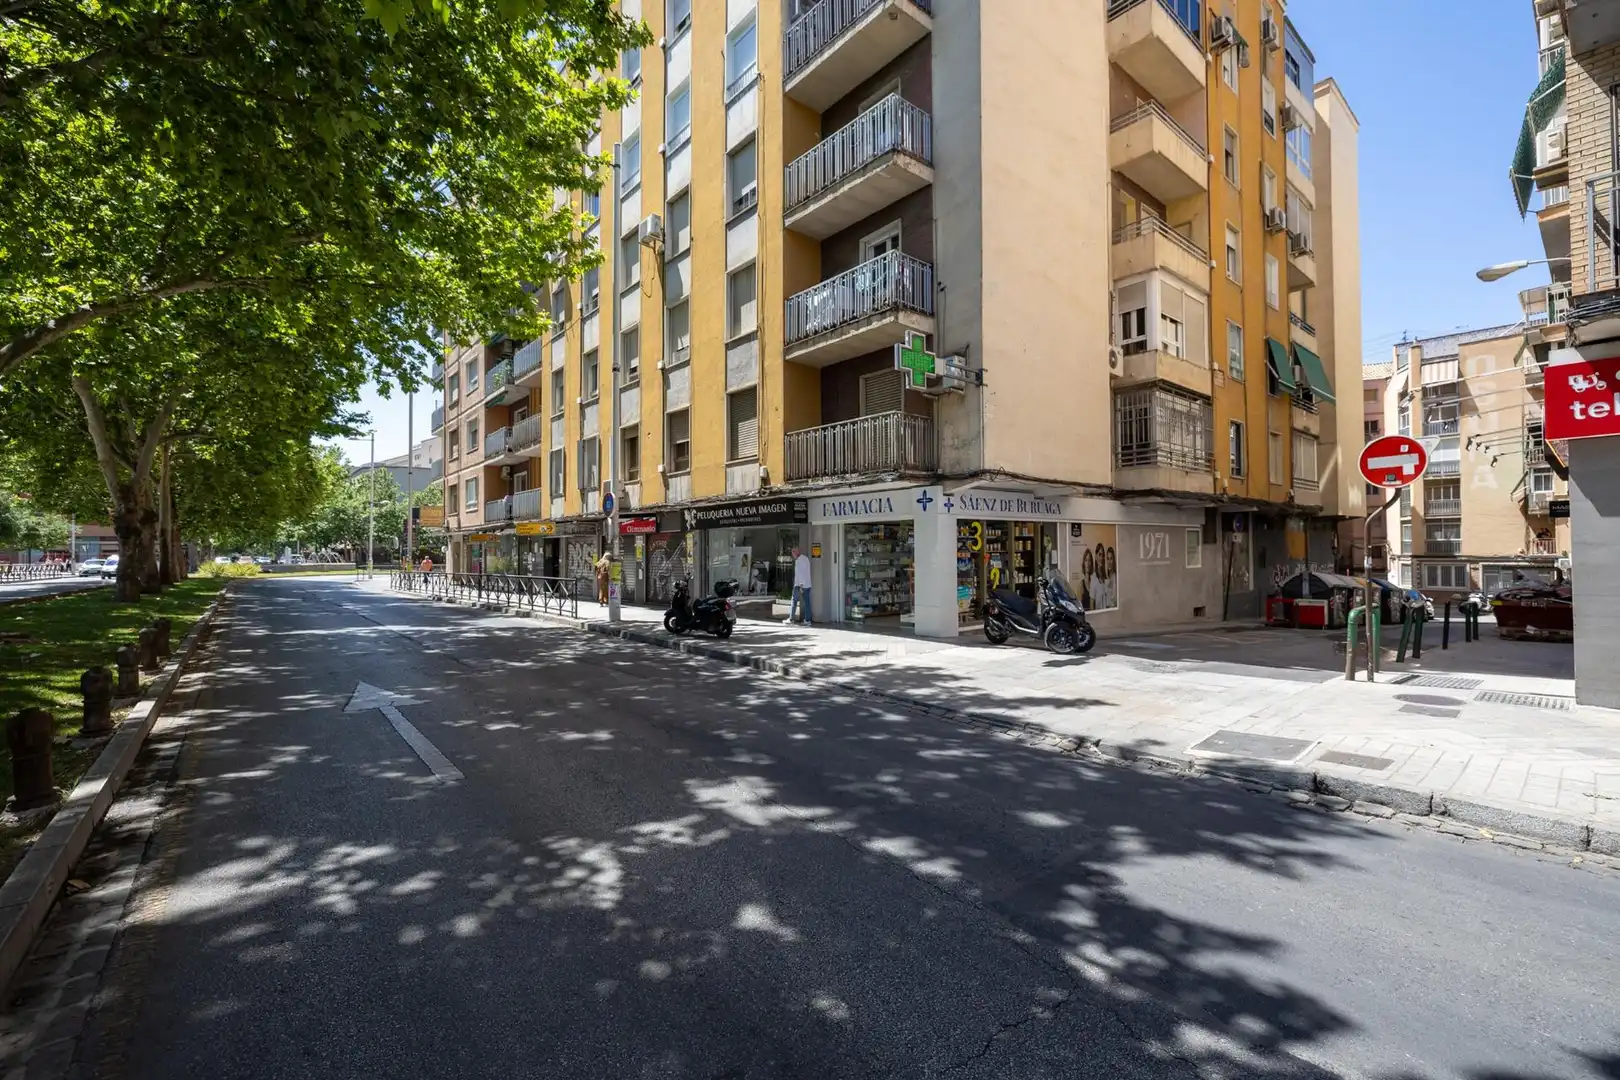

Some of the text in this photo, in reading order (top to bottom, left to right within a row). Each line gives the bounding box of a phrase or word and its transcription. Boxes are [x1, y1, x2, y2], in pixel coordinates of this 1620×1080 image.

[696, 509, 734, 521] PELUQUERIA
[735, 506, 757, 517] NUEVA
[758, 503, 787, 514] IMAGEN
[822, 496, 894, 517] FARMACIA
[959, 493, 1063, 515] SÁENZ DE BURUAGA
[626, 525, 656, 533] Gimnasio
[1139, 532, 1170, 559] 1971
